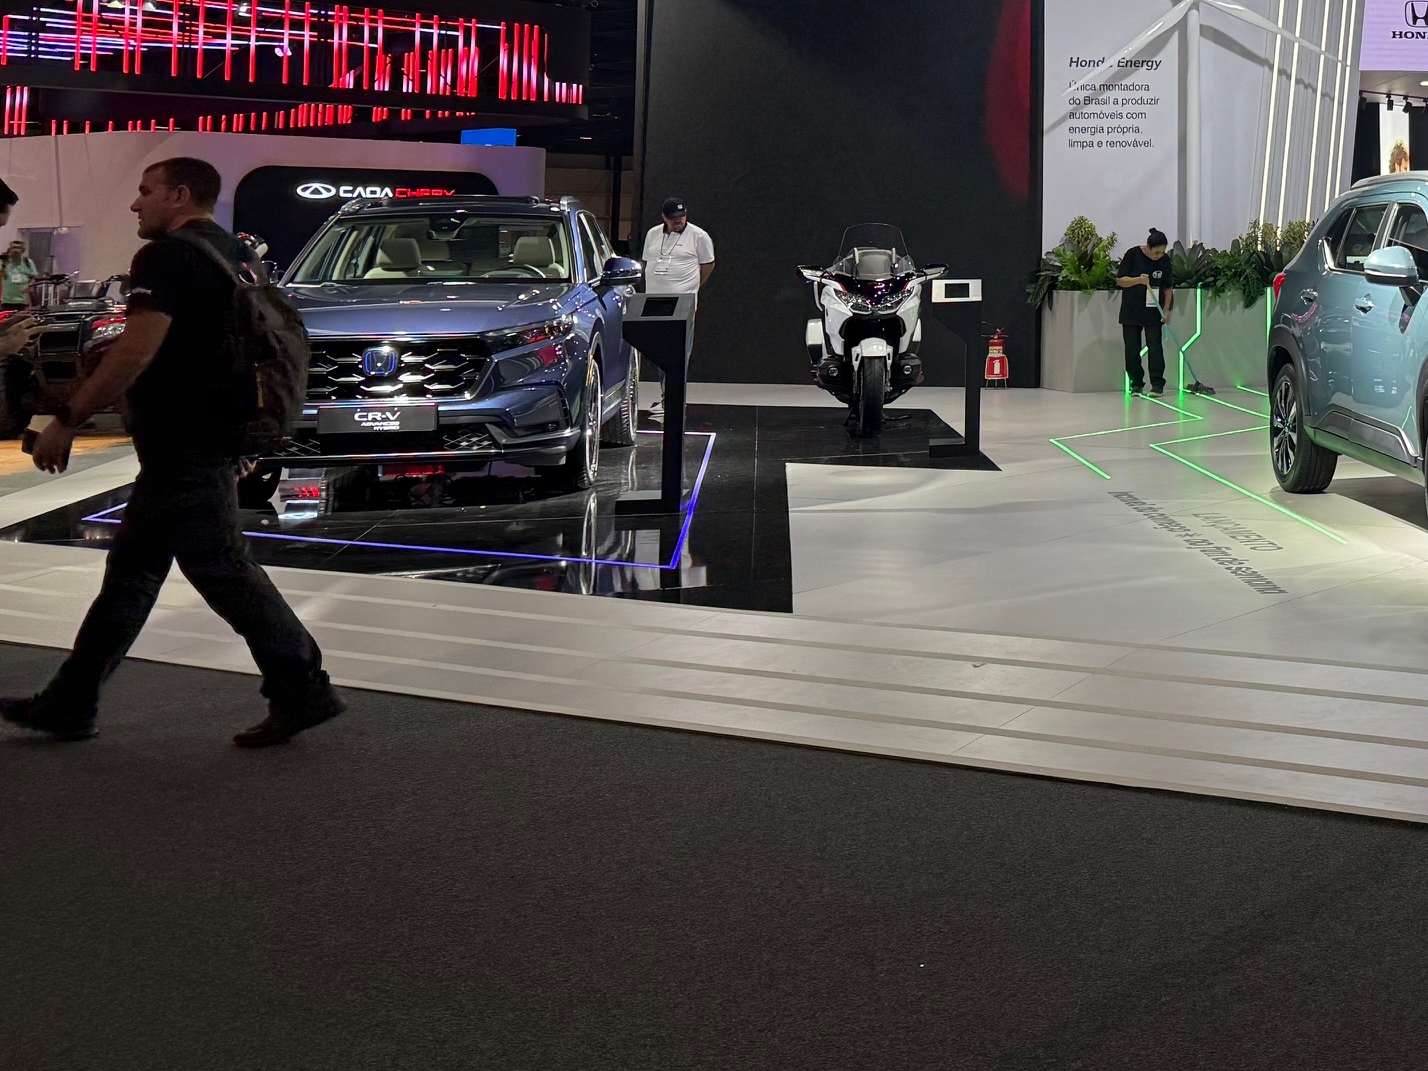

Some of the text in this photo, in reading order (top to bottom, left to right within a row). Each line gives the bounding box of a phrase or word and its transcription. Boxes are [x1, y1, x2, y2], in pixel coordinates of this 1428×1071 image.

[1069, 56, 1162, 71] Hond Energy
[1099, 82, 1150, 92] montadora
[1068, 95, 1160, 108] do Brasil a produzir
[1068, 109, 1147, 120] automóveis com
[1068, 124, 1105, 136] energia
[1068, 138, 1155, 150] limpa e renovável.
[353, 411, 401, 421] CR-V
